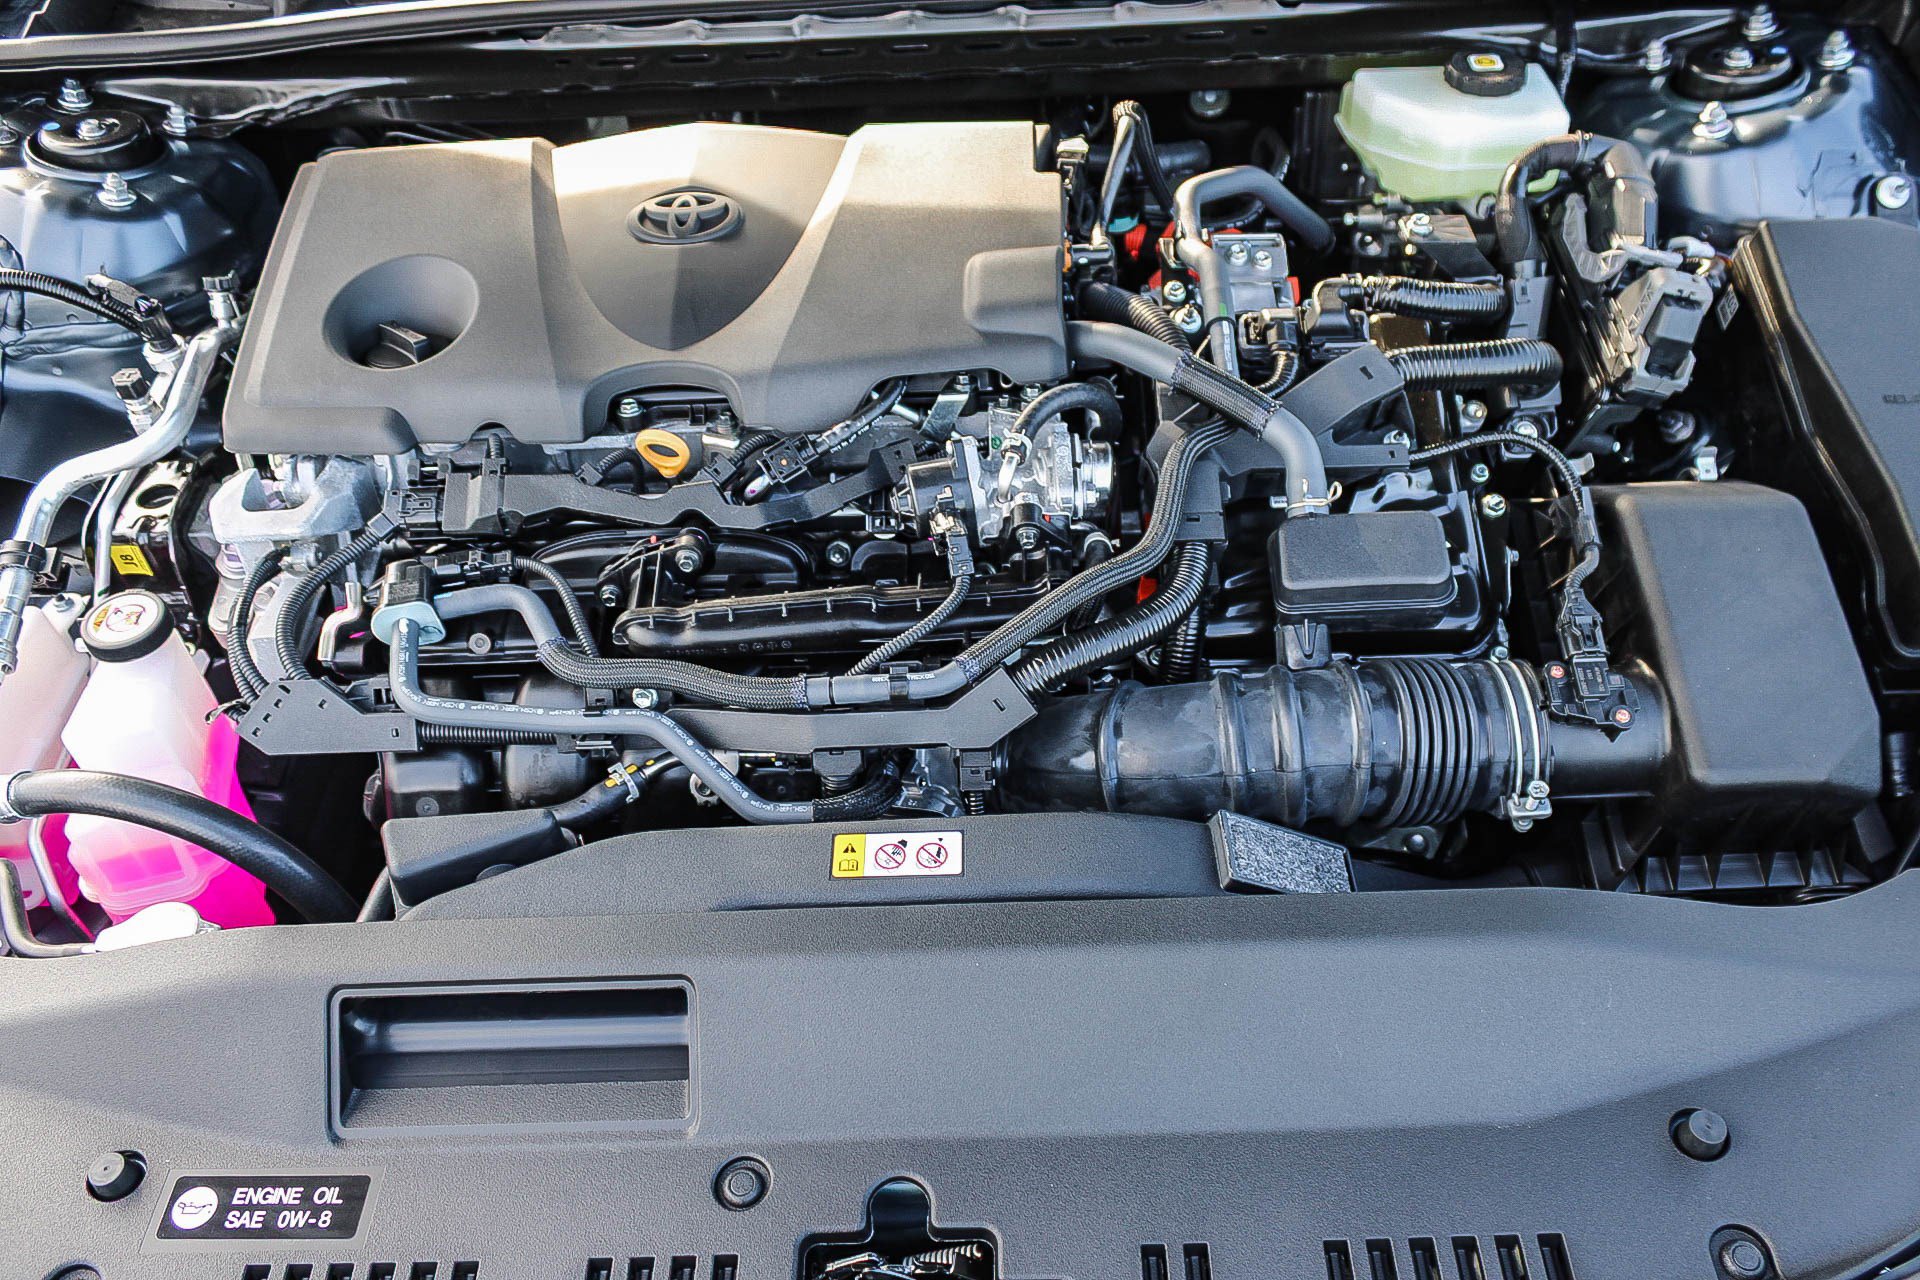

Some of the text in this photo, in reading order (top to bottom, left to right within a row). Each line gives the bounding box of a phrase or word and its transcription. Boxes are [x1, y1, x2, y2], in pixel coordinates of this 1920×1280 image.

[120, 555, 138, 567] J8
[231, 1186, 344, 1205] ENGINE OIL
[224, 1210, 332, 1229] SAE 0W-8
